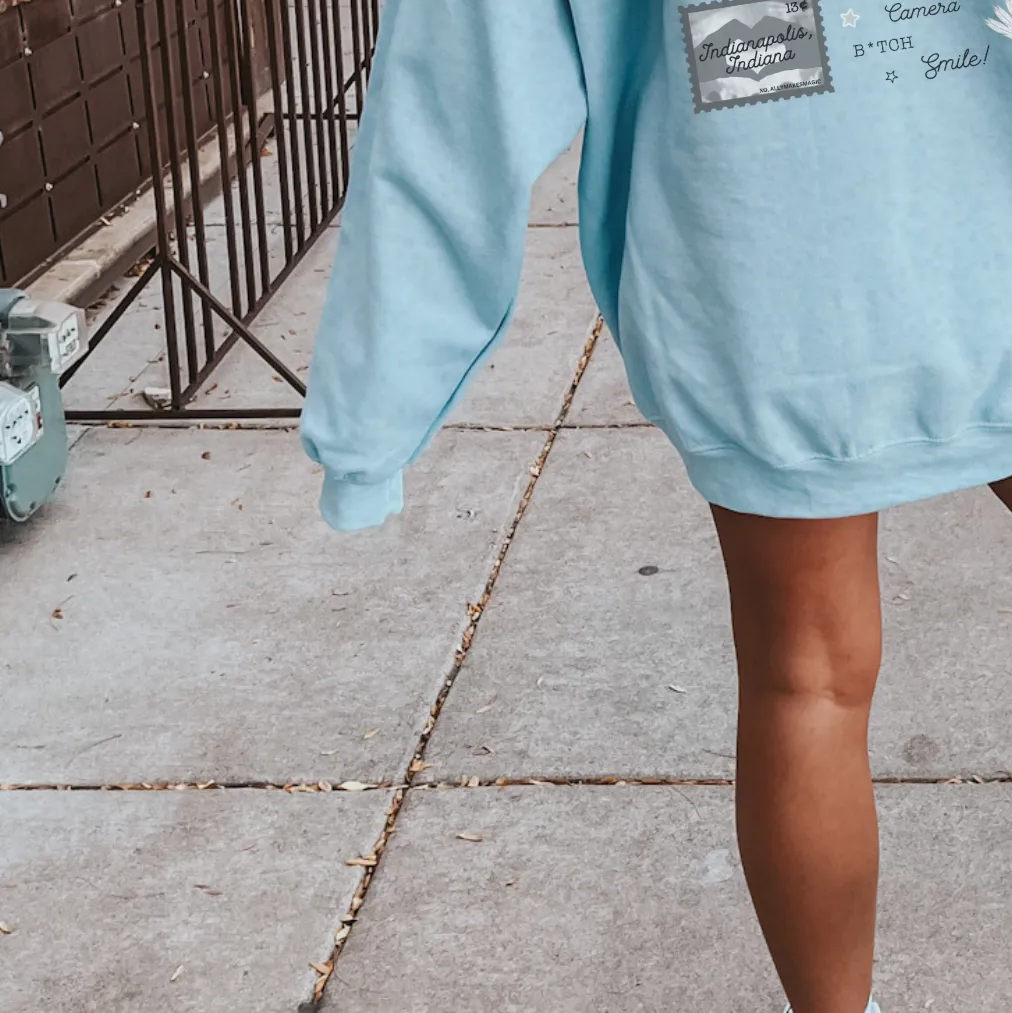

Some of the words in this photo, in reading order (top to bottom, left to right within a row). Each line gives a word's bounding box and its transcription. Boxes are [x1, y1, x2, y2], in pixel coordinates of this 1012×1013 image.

[884, 0, 961, 22] Camera
[699, 24, 814, 62] Indianapolis,
[725, 49, 796, 74] Indiana
[921, 44, 990, 80] Smile!
[770, 79, 822, 91] ALLYMAKESMAGIC
